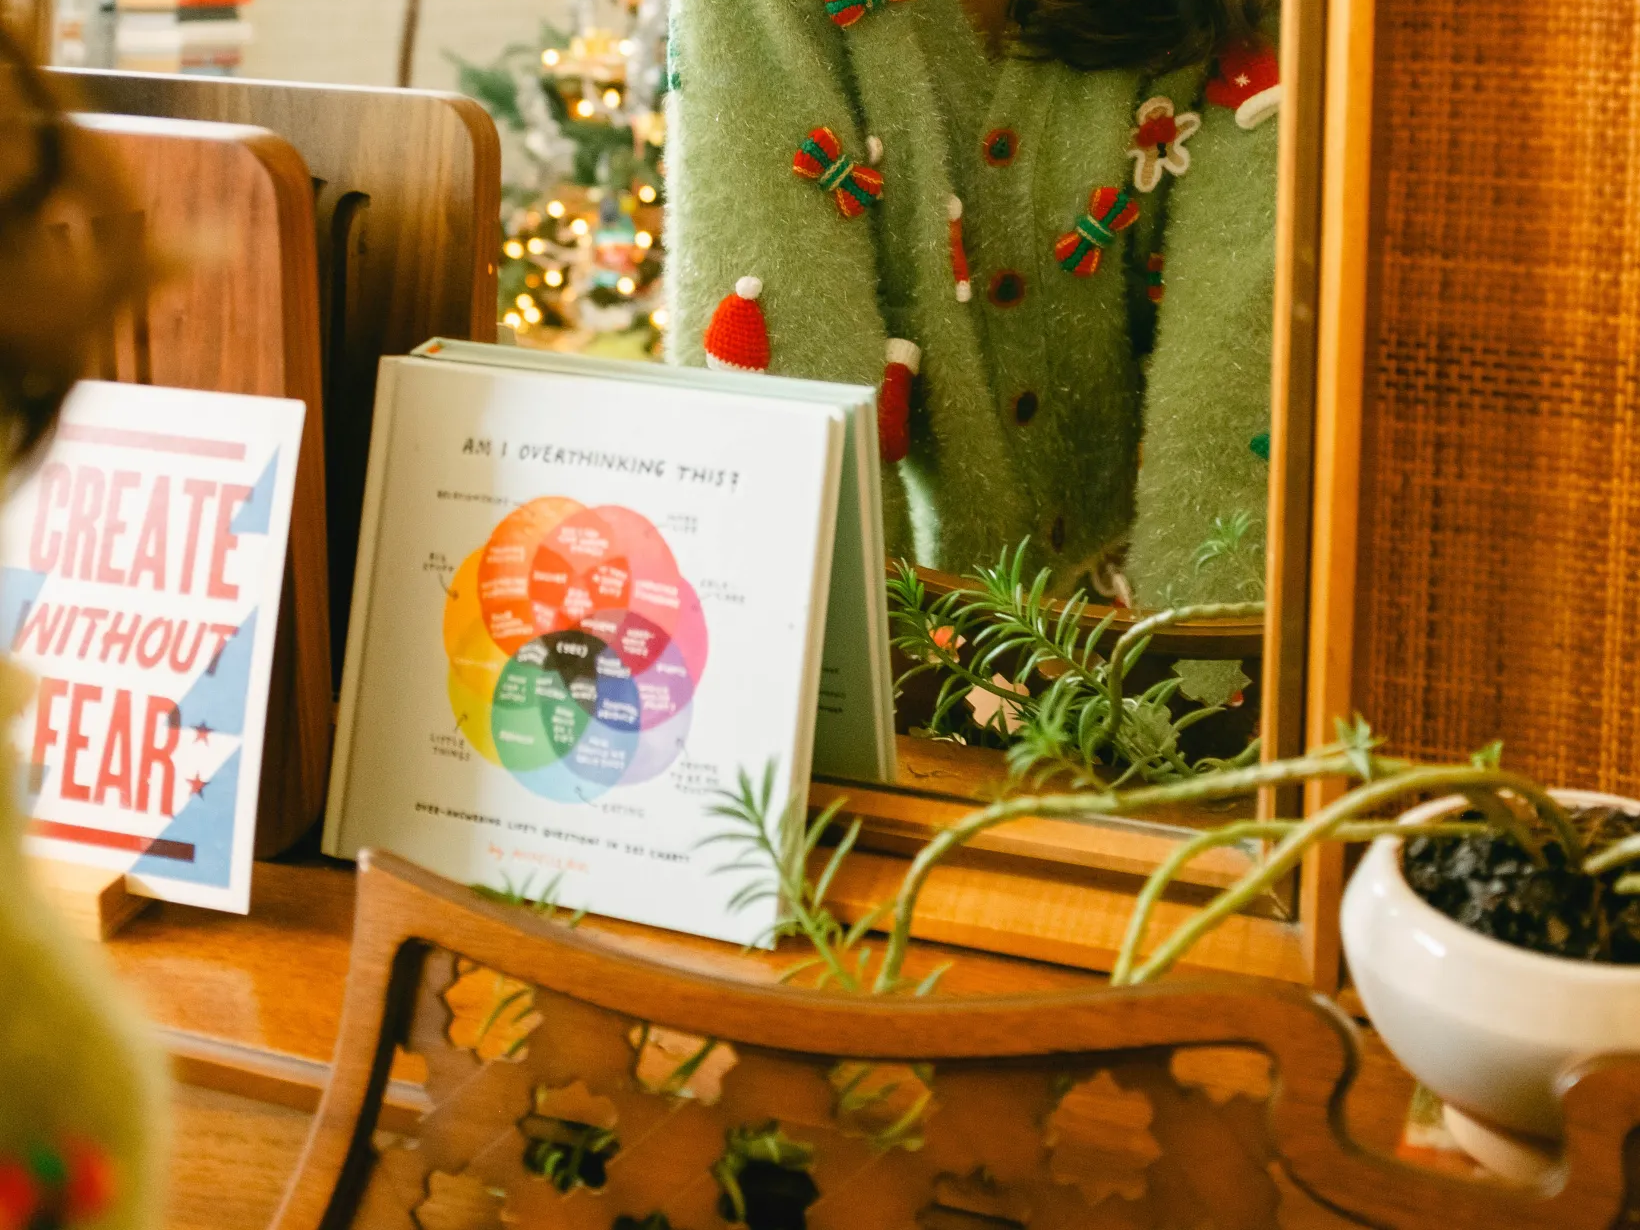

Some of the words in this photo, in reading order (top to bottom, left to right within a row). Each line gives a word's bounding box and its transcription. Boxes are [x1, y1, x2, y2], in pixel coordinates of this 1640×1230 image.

[462, 437, 492, 456] AM
[501, 441, 507, 458] I
[519, 443, 666, 478] OVERTHINKING
[677, 464, 742, 495] THIS?
[28, 461, 254, 602] CREATE
[9, 598, 240, 677] WITHOUT
[27, 676, 181, 816] FEAR
